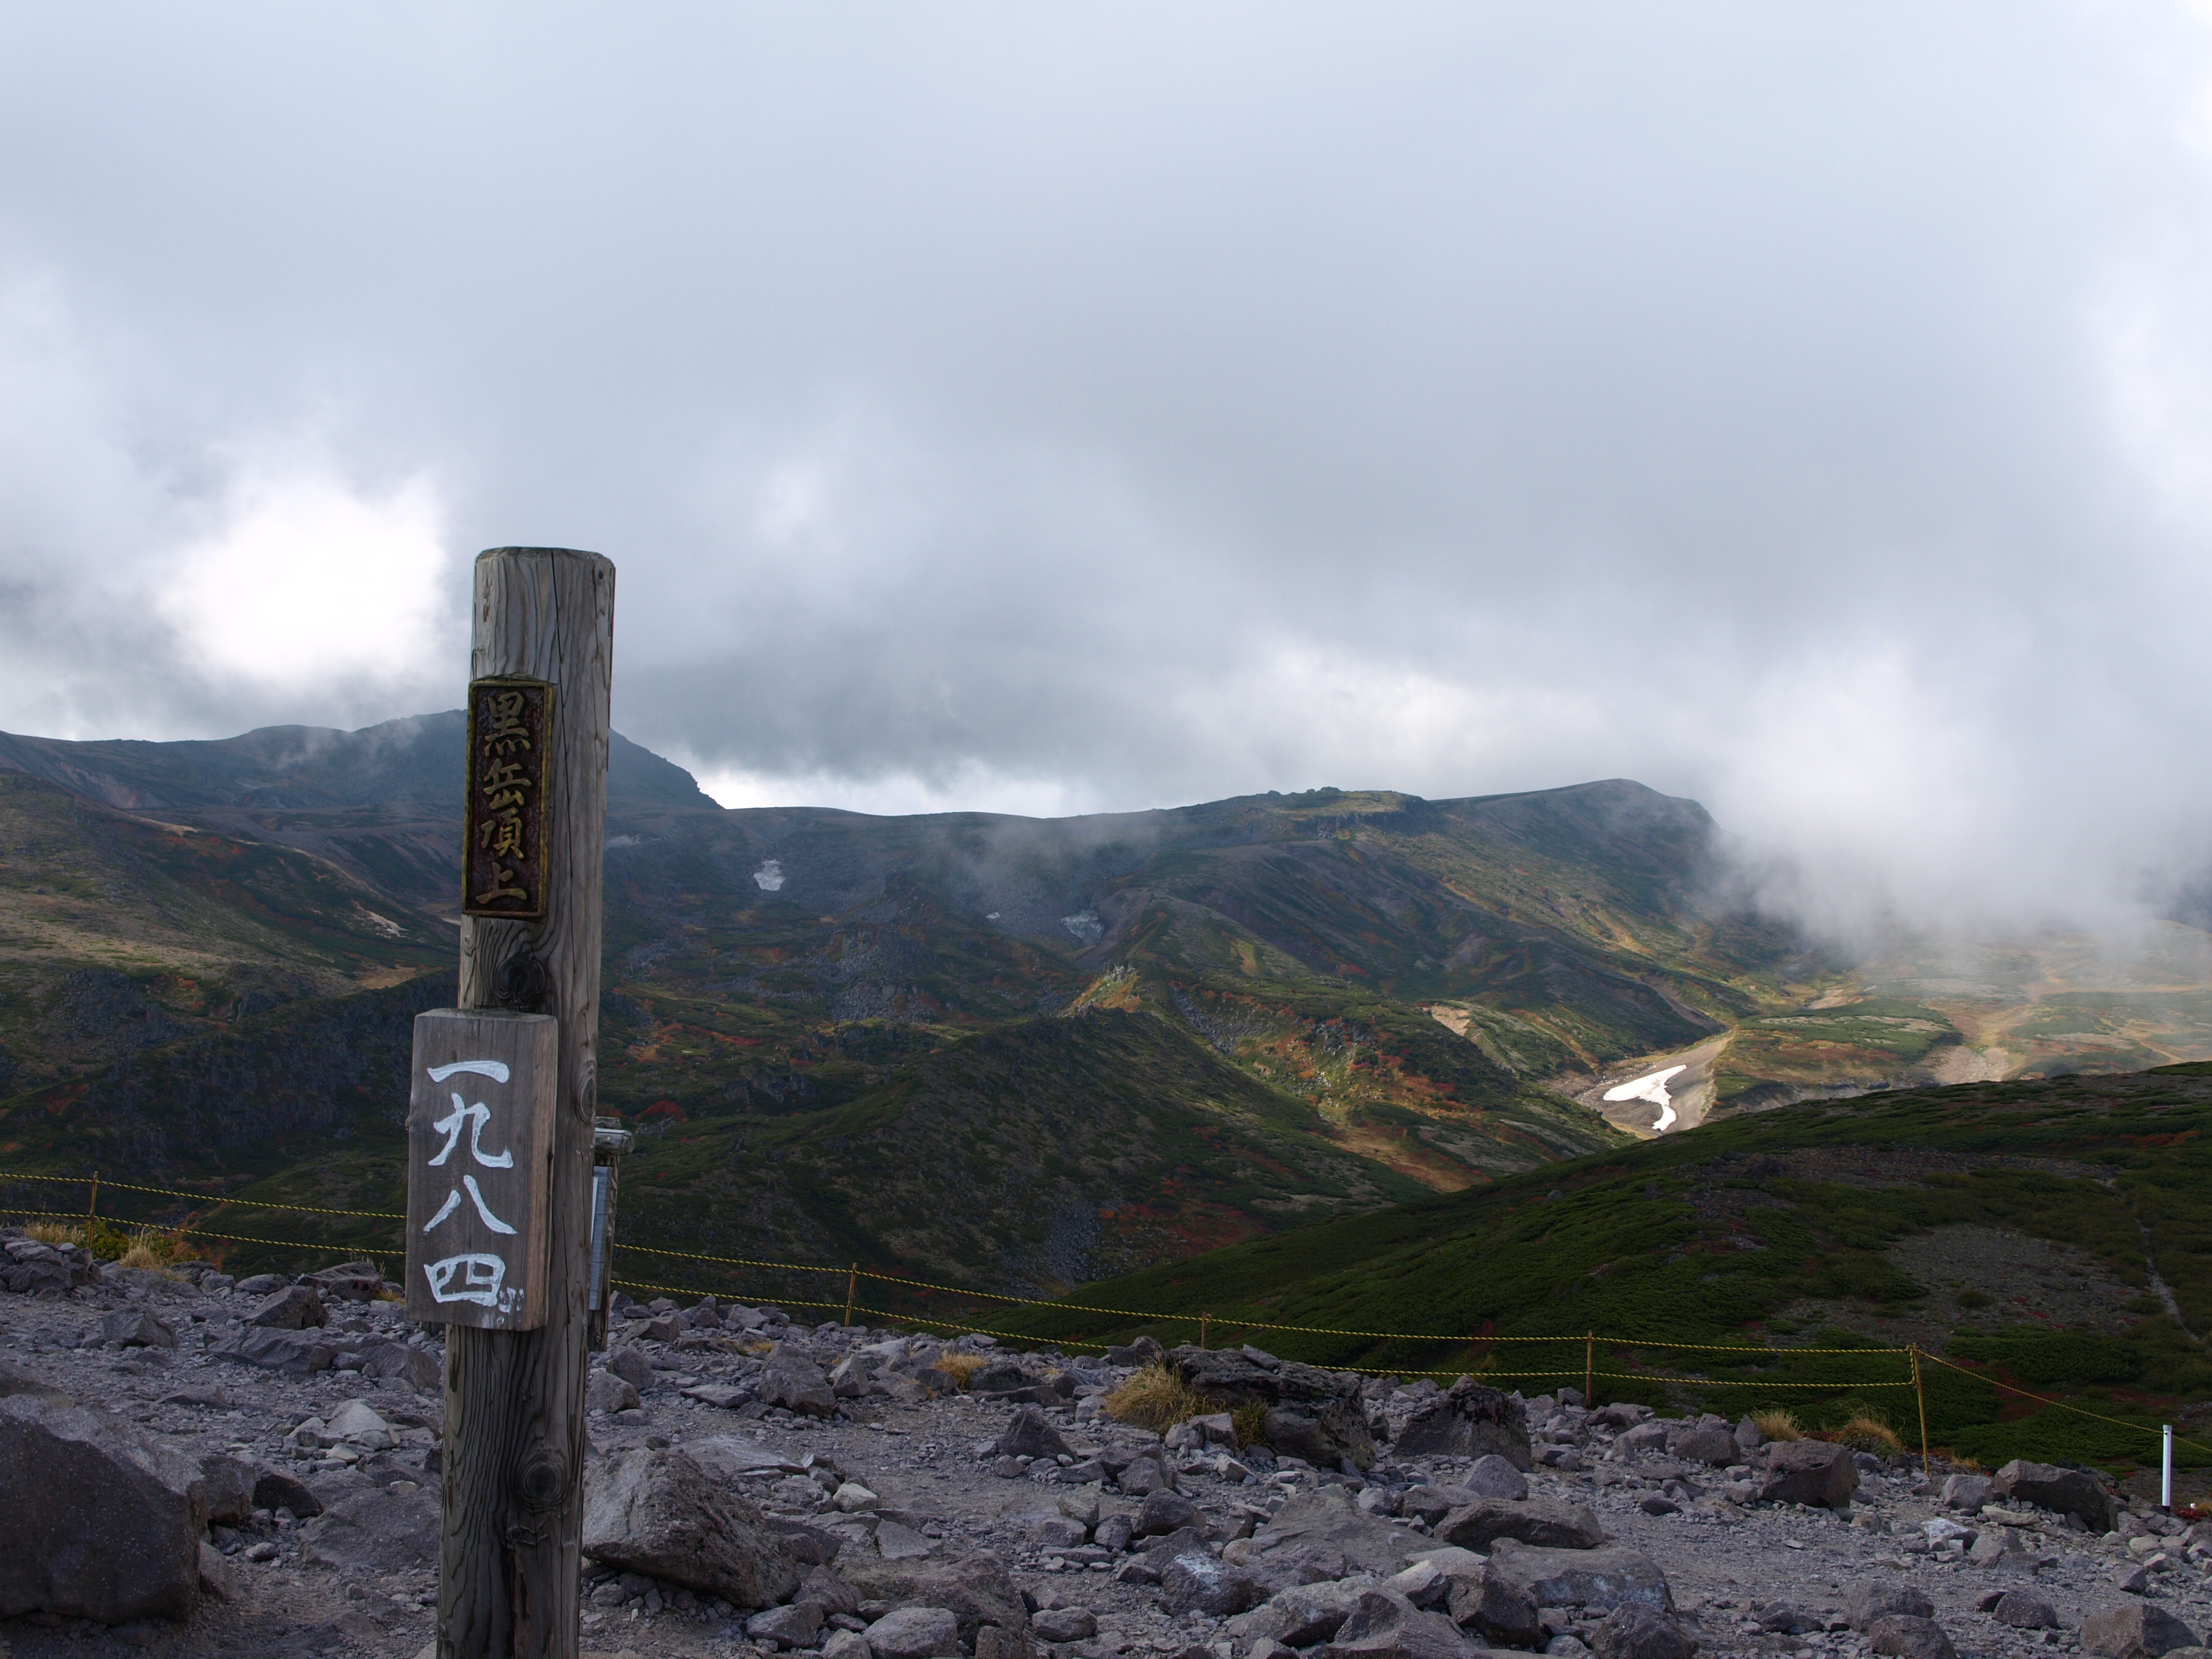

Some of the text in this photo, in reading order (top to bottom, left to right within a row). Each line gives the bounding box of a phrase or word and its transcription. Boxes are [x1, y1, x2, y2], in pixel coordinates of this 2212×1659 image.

[477, 691, 531, 905] 黒岳頂上
[424, 1060, 518, 1307] 一九八四
